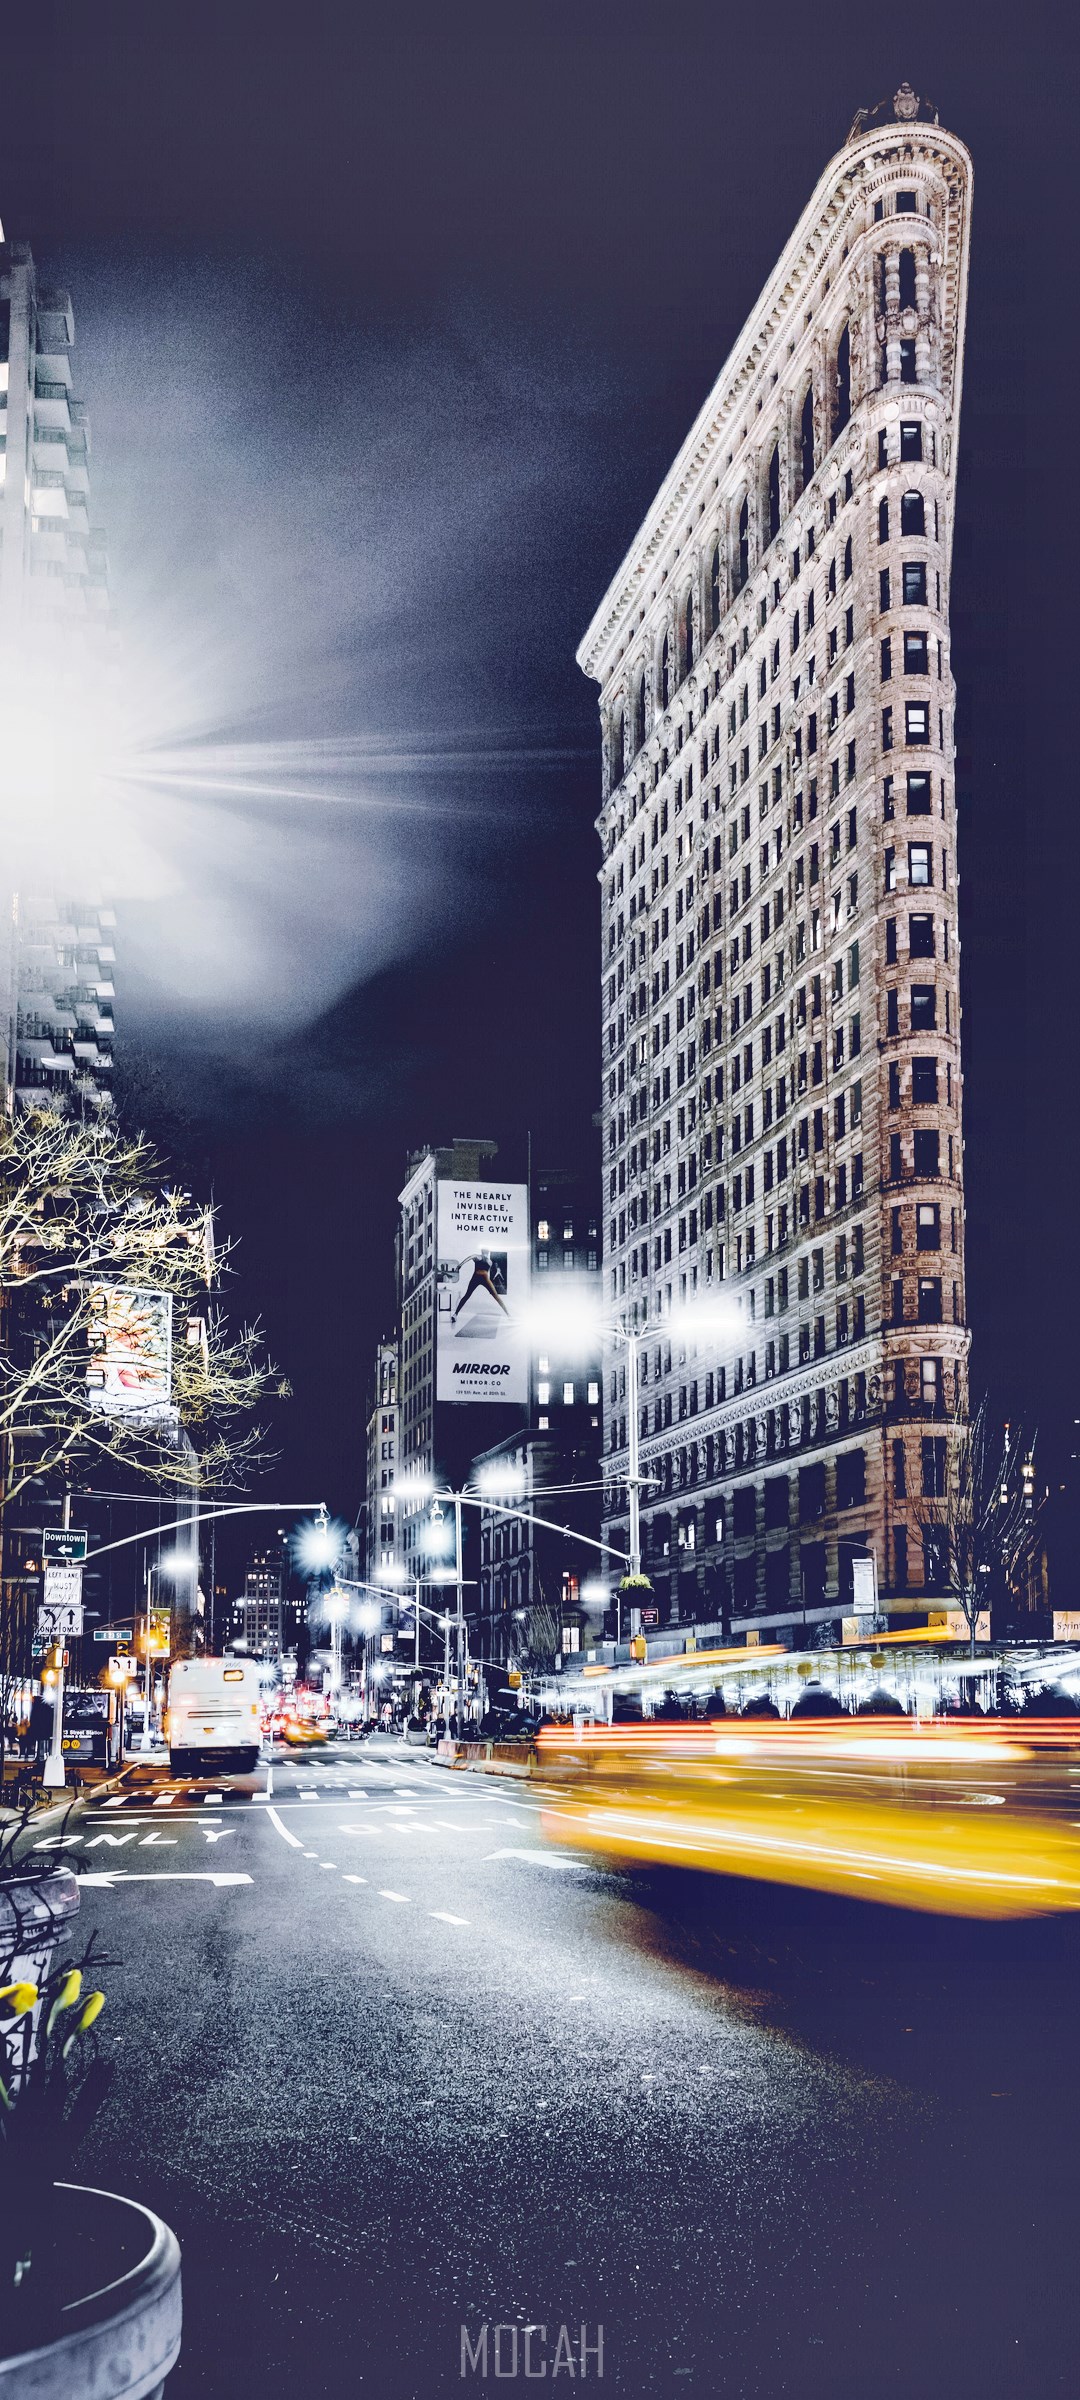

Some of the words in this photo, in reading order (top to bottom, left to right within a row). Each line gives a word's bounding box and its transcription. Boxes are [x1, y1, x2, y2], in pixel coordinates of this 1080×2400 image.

[454, 1191, 472, 1199] THE
[476, 1192, 512, 1201] NEARLY
[457, 1202, 509, 1212] INVISIBLE,
[451, 1213, 514, 1223] INTERACTIVE
[457, 1224, 484, 1232] HOME
[452, 1363, 511, 1375] MIRROR
[45, 1532, 86, 1543] Downtown
[64, 1571, 79, 1579] LANE
[53, 1582, 73, 1590] MUST
[130, 1786, 236, 1796] ONLY
[337, 1818, 533, 1835] ONLY
[32, 1829, 237, 1849] ONLY
